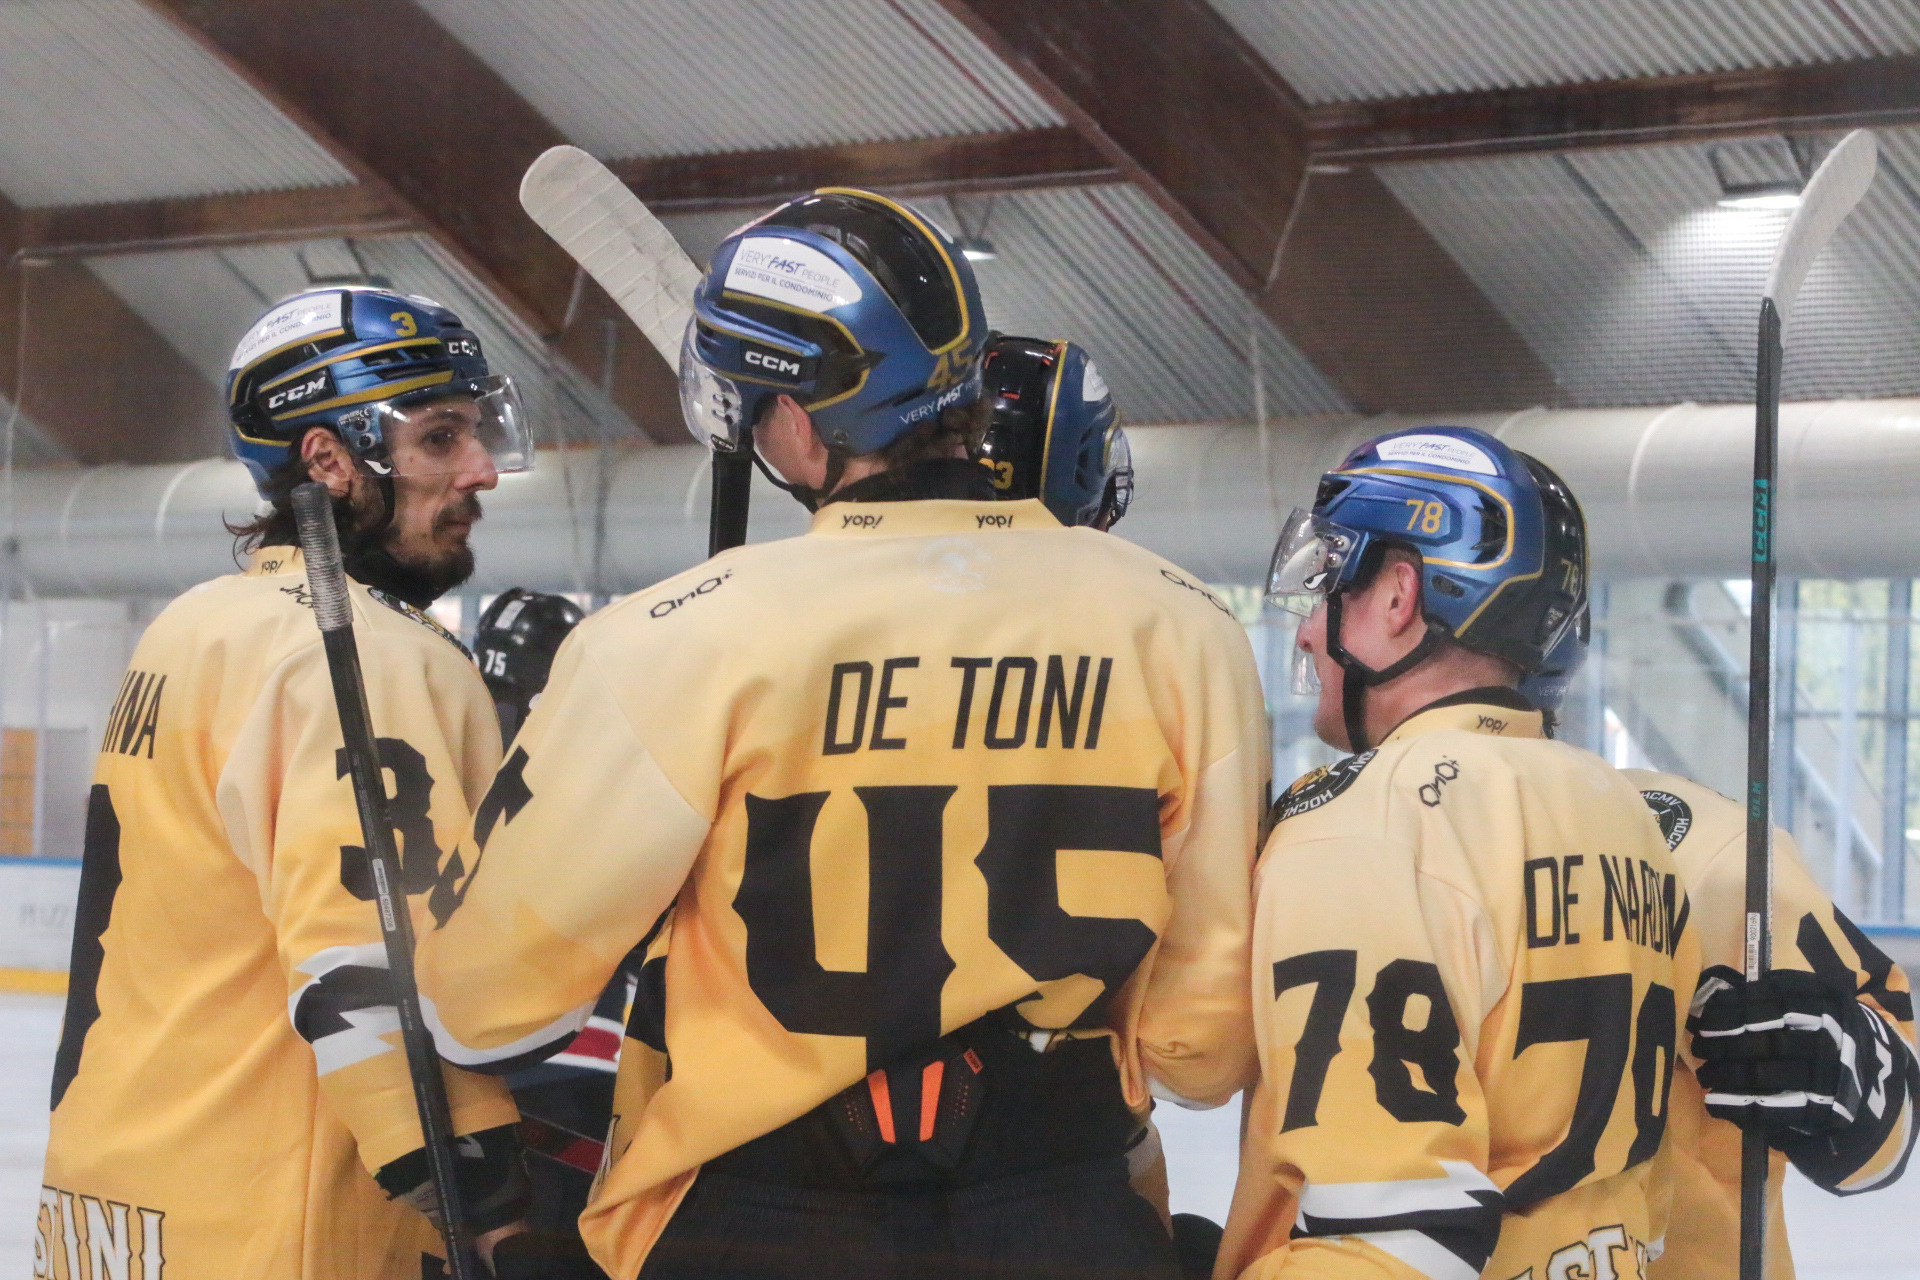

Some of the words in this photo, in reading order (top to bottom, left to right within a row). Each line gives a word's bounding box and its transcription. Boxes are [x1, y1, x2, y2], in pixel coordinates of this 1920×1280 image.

[735, 267, 756, 279] SERVIZI
[757, 273, 771, 283] PER
[771, 277, 778, 285] IL
[779, 279, 833, 302] CONDOMINIO
[740, 249, 768, 266] VERY
[767, 256, 806, 274] FAST
[801, 268, 840, 287] PEOPLE
[258, 333, 270, 346] PER
[279, 313, 332, 334] CONDNIO
[390, 311, 417, 337] 3
[744, 351, 800, 375] CCM
[927, 338, 972, 394] 45
[268, 375, 326, 409] CCM
[900, 401, 935, 424] VERY
[937, 382, 964, 411] FAST
[1393, 441, 1419, 449] VERY
[1419, 442, 1451, 451] FAST
[1447, 447, 1475, 457] PEOPLE
[1428, 453, 1471, 464] CONDOMINIO
[841, 514, 884, 530] yop!
[976, 514, 1014, 529] yop!
[1405, 499, 1444, 534] 78
[1754, 486, 1766, 555] CCM
[261, 560, 284, 574] yop!
[821, 656, 920, 757] DE
[950, 654, 1114, 751] TONI
[1476, 714, 1509, 735] yop!
[335, 737, 444, 901] 3
[1524, 854, 1584, 949] DE
[731, 784, 1165, 1080] 45
[1272, 949, 1467, 1134] 78
